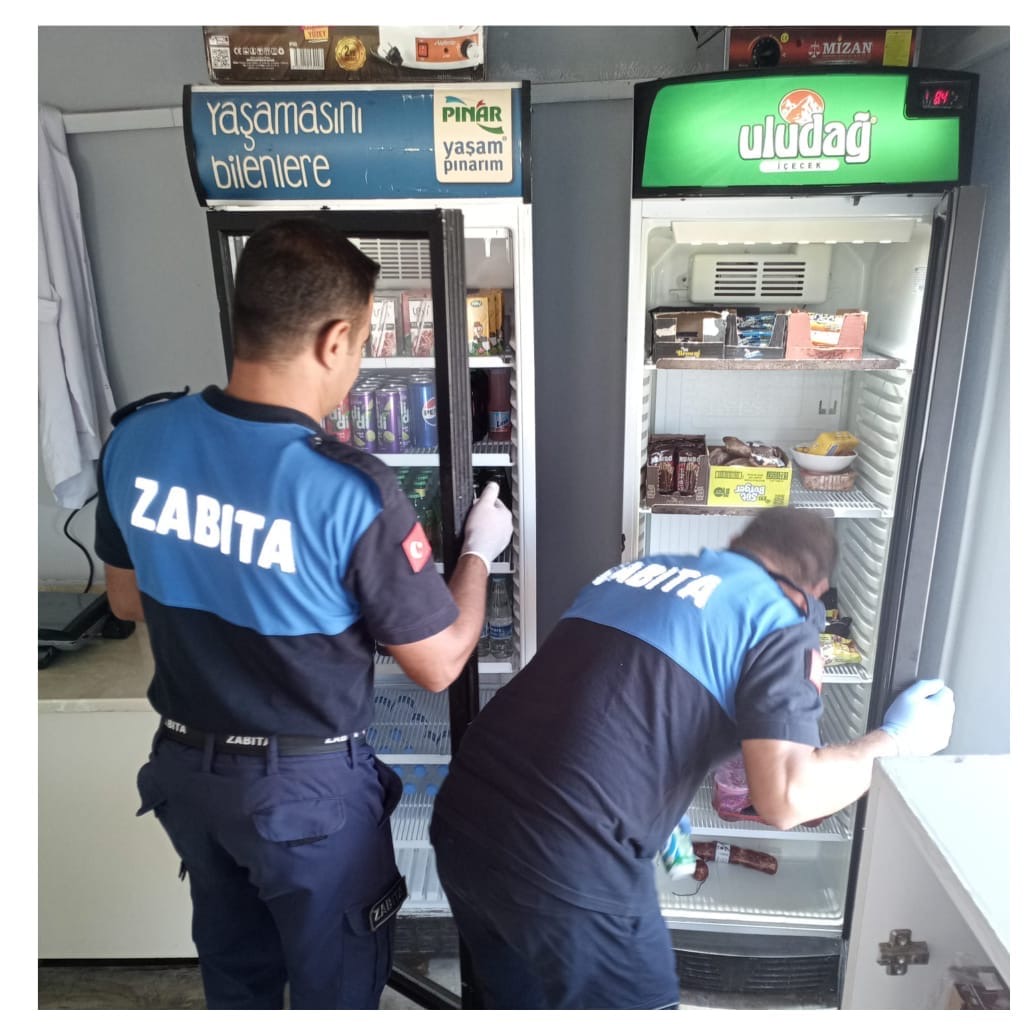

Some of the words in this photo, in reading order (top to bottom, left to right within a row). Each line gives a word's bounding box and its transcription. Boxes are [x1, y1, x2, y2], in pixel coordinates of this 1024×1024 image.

[823, 41, 873, 55] MİZAN
[443, 139, 503, 158] yaşam
[737, 110, 873, 164] uludağ
[211, 153, 332, 189] bilenlere
[776, 161, 823, 172] İÇECEK
[130, 476, 296, 574] ZABITA
